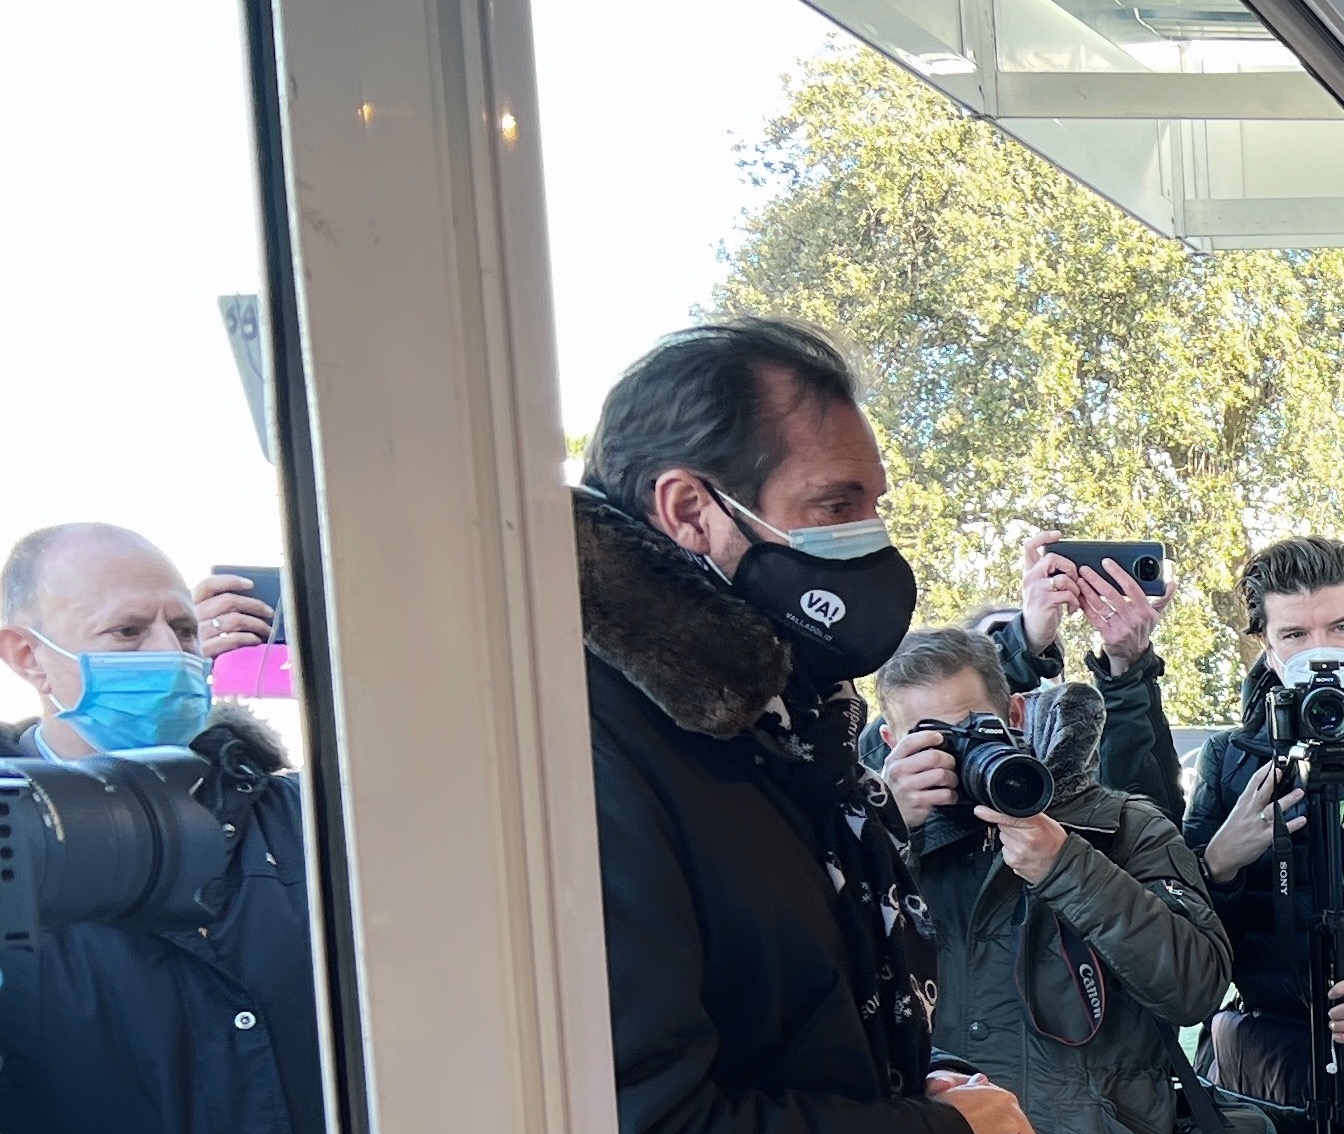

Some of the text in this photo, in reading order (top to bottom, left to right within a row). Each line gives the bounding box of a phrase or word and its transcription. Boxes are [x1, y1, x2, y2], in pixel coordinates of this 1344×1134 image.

[808, 592, 840, 621] VA!
[1279, 861, 1288, 896] SONY
[1079, 963, 1102, 1019] Canon
